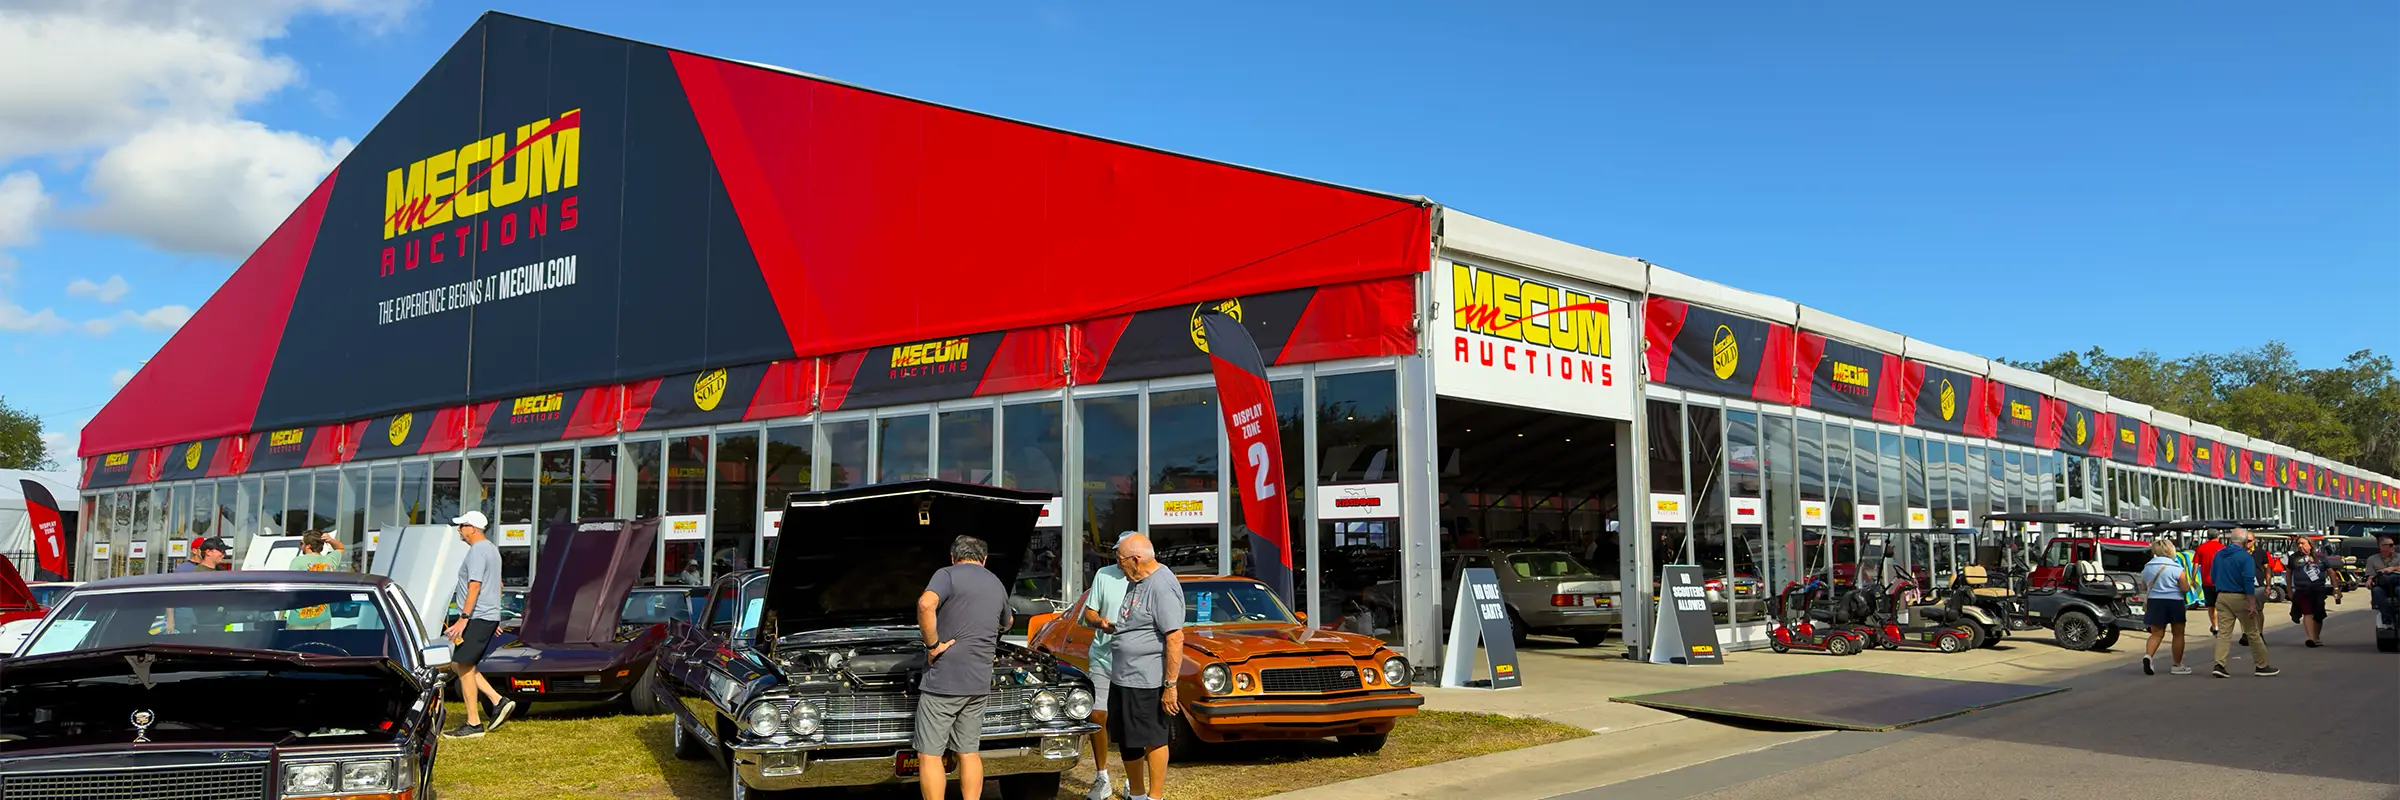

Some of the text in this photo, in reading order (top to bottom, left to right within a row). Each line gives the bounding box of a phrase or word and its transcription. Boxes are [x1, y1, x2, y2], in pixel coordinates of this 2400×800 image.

[383, 108, 581, 240] MECUM
[380, 195, 579, 277] AUCTIONS
[378, 254, 577, 326] THE EXPERIENCE BEGINS AT MECUM.COM
[1452, 262, 1612, 359] MECUM
[891, 338, 969, 368] MECUM
[1454, 336, 1613, 387] AUCTIONS
[1715, 345, 1737, 371] SOLD
[889, 361, 967, 379] AUCTIONS
[1833, 361, 1868, 387] MECUM
[696, 377, 725, 404] SOLD
[512, 393, 563, 415] MECUM
[1232, 402, 1263, 427] DISPLAY
[510, 411, 560, 424] AUCTIONS
[270, 428, 304, 447] MECUM
[1242, 420, 1262, 440] ZONE
[1247, 441, 1276, 502] 2
[1163, 500, 1203, 512] MECUM
[39, 520, 57, 530] DISPLAY
[48, 535, 60, 558] 1
[1680, 573, 1691, 584] NO
[1472, 583, 1485, 600] NO
[1482, 583, 1500, 600] GOLF
[1672, 586, 1706, 598] SCOOTERS
[1480, 603, 1504, 620] CARTS
[1677, 599, 1707, 611] ALLOWED
